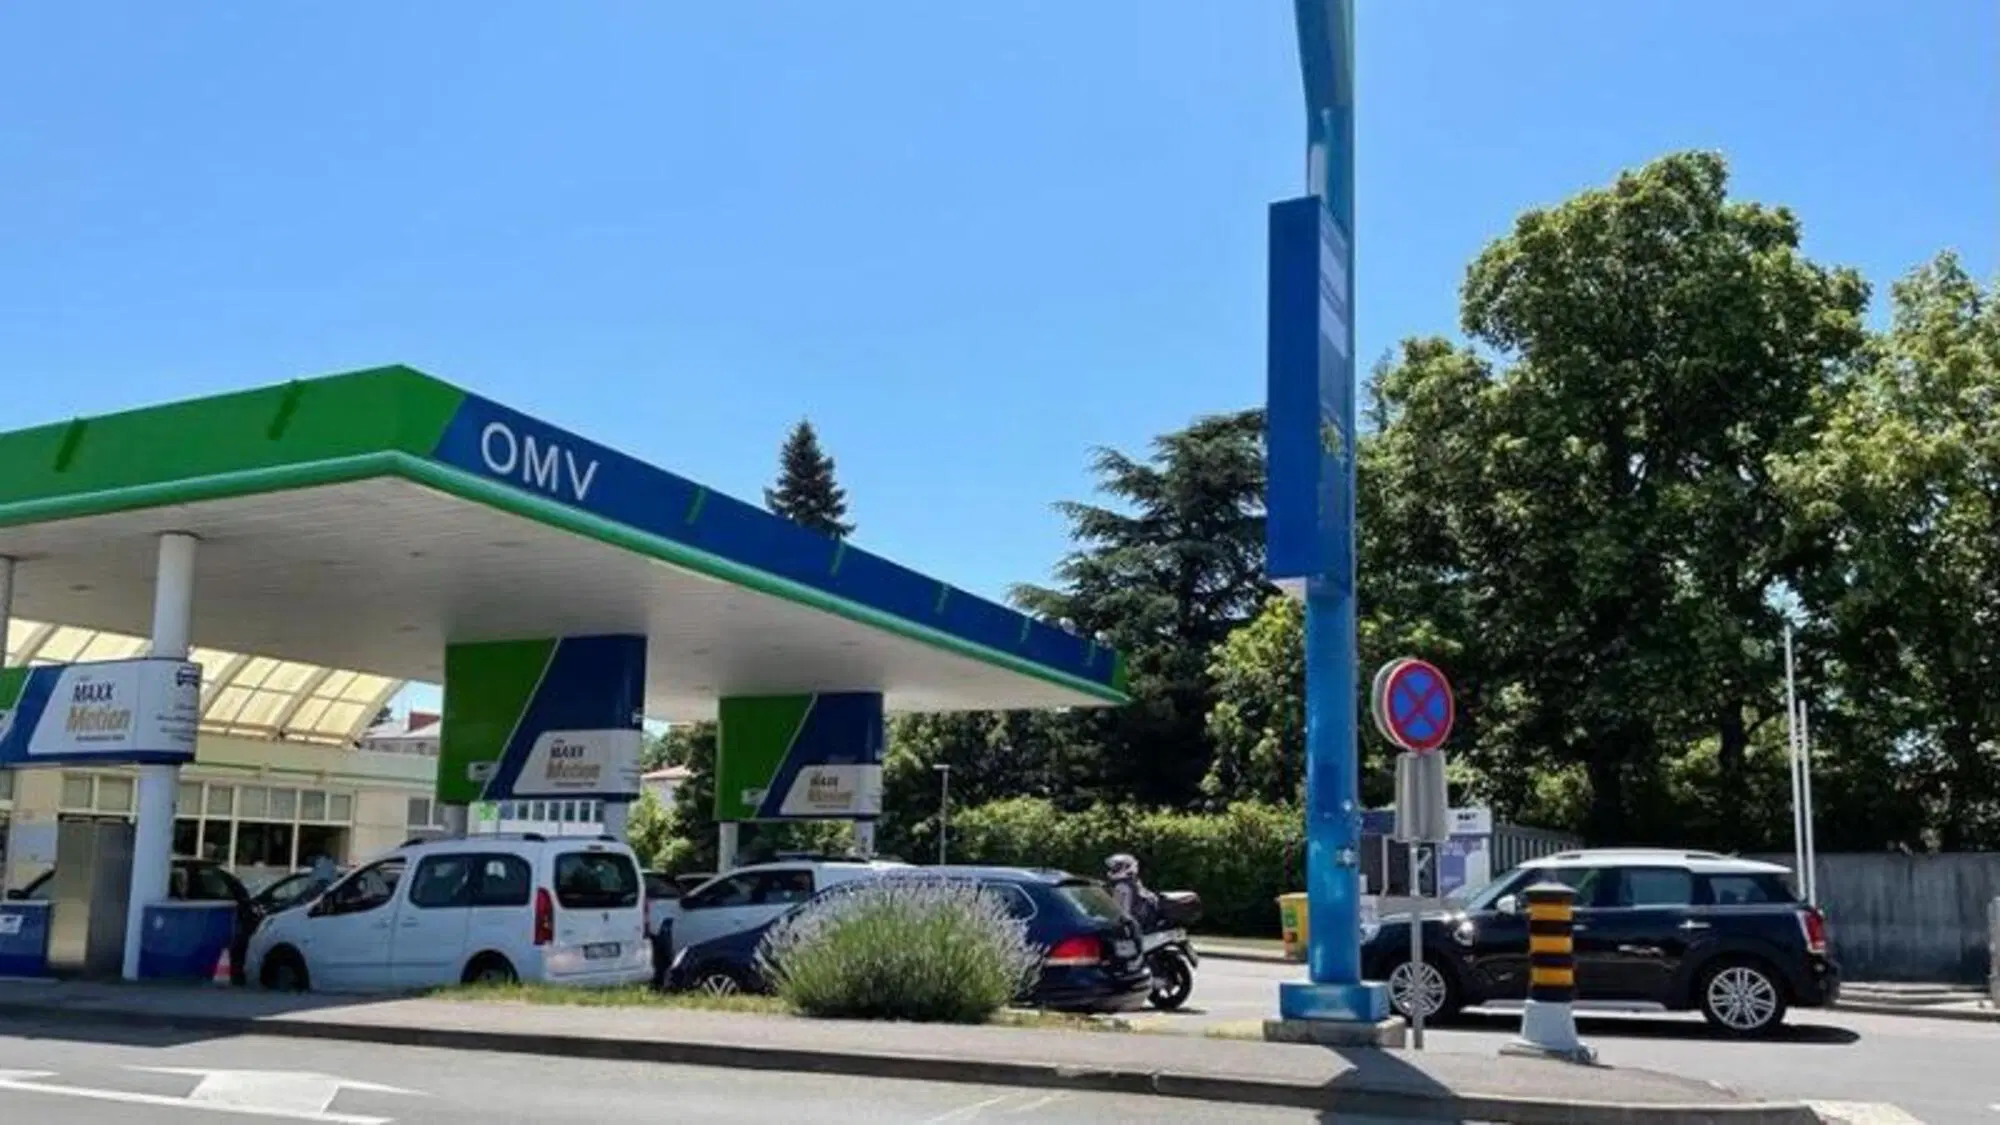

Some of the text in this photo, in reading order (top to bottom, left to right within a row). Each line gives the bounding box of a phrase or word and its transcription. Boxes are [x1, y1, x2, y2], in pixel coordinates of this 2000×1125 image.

[481, 421, 600, 501] OMV
[73, 681, 115, 701] MAXX
[66, 704, 131, 732] Motion
